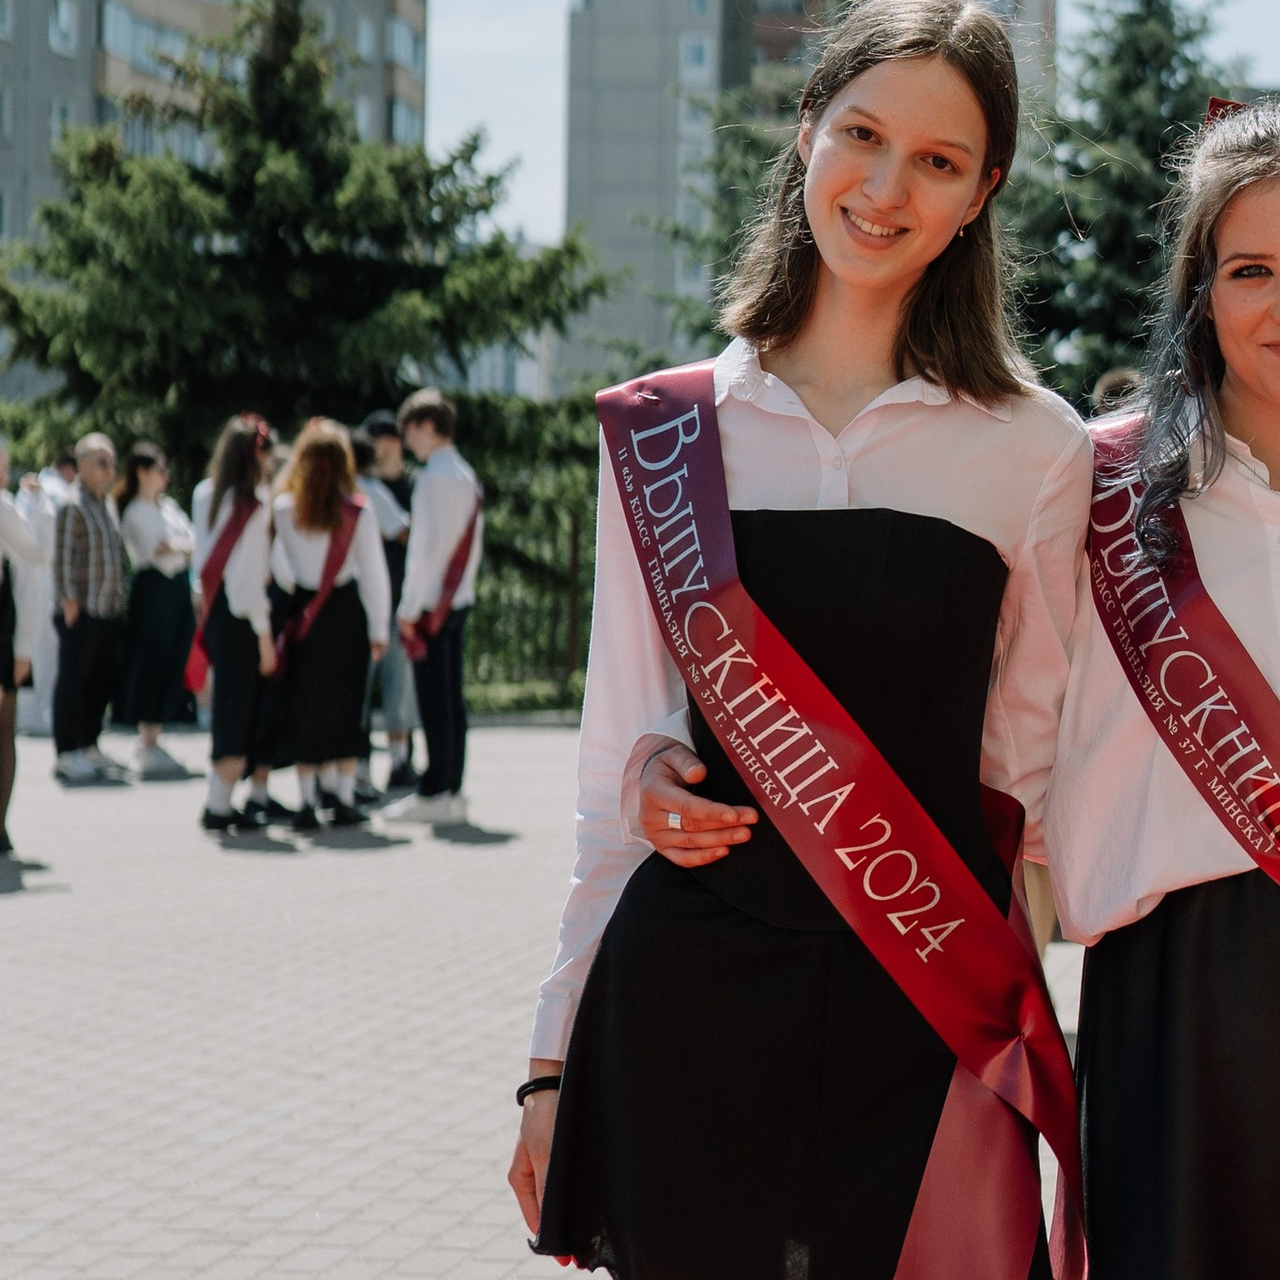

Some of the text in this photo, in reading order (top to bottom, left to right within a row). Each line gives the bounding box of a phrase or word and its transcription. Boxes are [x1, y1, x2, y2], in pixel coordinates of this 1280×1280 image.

[629, 495, 651, 549] КЛАСС
[647, 556, 690, 660] ГИМНАЗИЯ
[687, 662, 701, 685] №
[700, 688, 716, 706] 37
[714, 711, 728, 728] Г.
[726, 729, 783, 807] МИНСКА
[1111, 617, 1166, 713] ГИМНАЗИЯ
[1162, 713, 1180, 736] №
[1178, 736, 1197, 756] 37
[1193, 758, 1209, 776] Г.
[1206, 775, 1264, 851] МИНСКА
[834, 812, 966, 964] 2024
